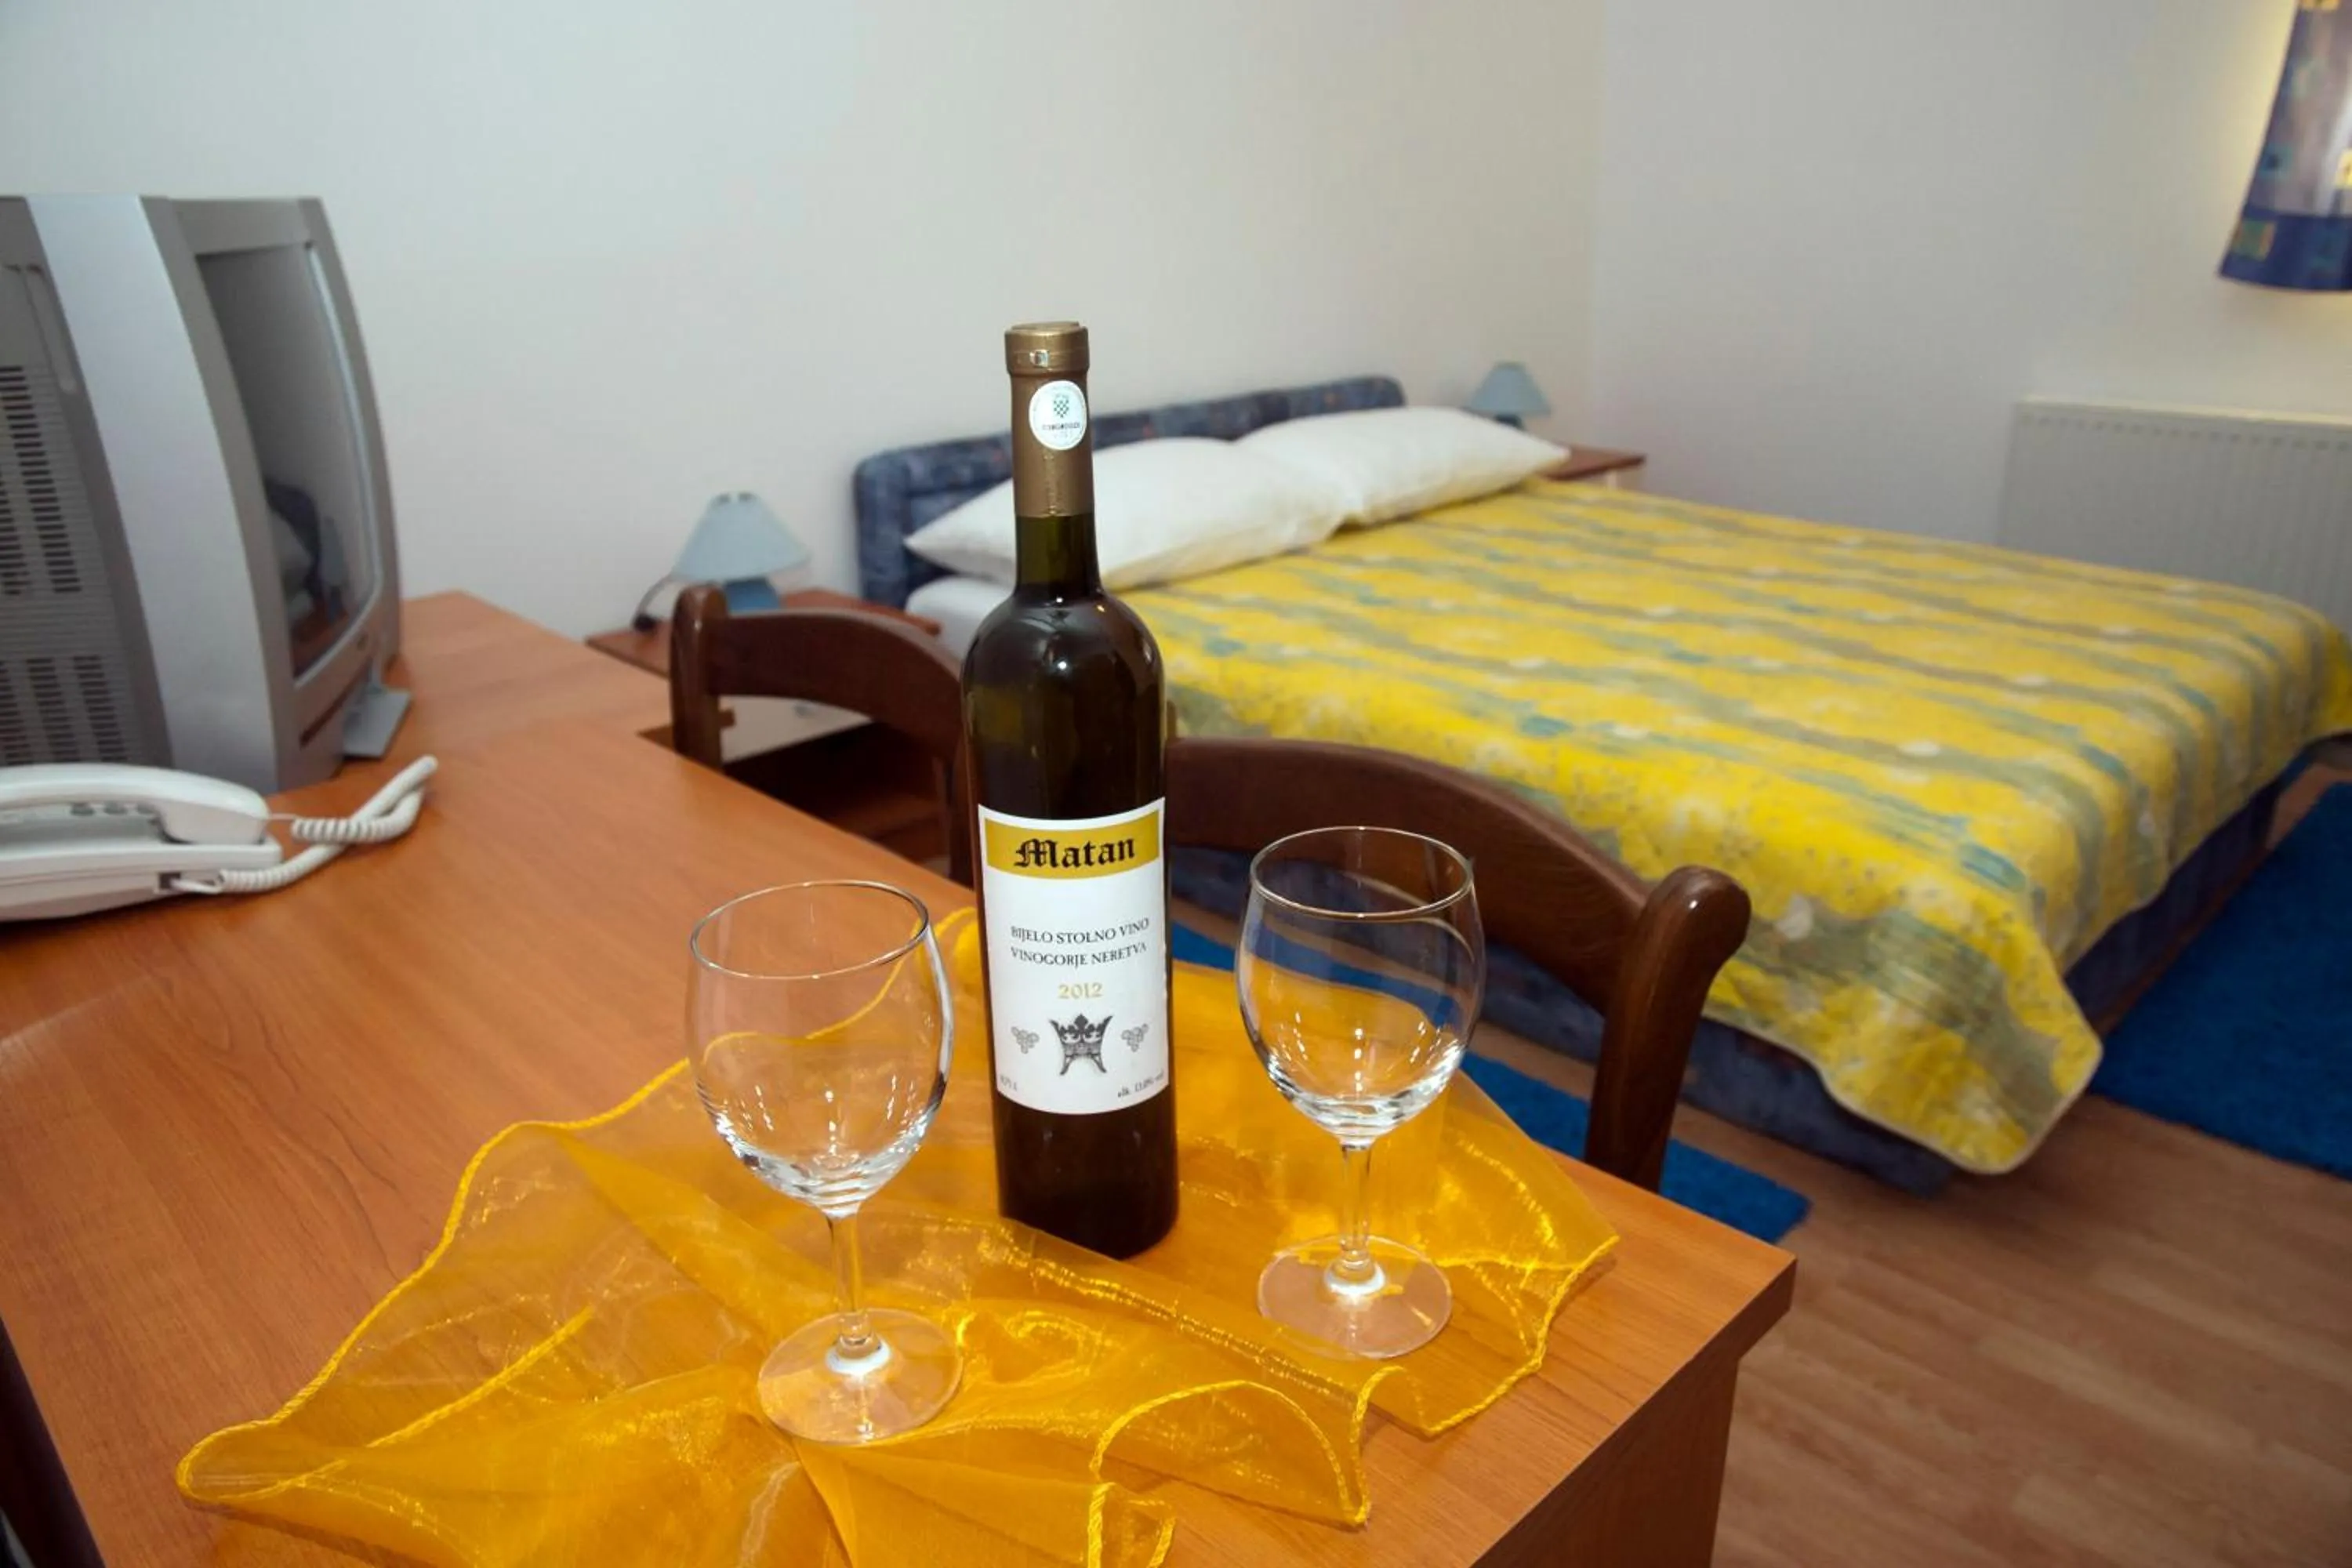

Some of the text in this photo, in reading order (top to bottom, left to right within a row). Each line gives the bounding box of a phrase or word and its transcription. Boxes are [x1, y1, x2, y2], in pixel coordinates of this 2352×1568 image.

[1014, 838, 1135, 868] Matan
[1011, 918, 1149, 944] BIJELO STOLNO VINO
[1011, 942, 1147, 969] VINOGORJE NERETVA
[1058, 983, 1103, 1000] 2012
